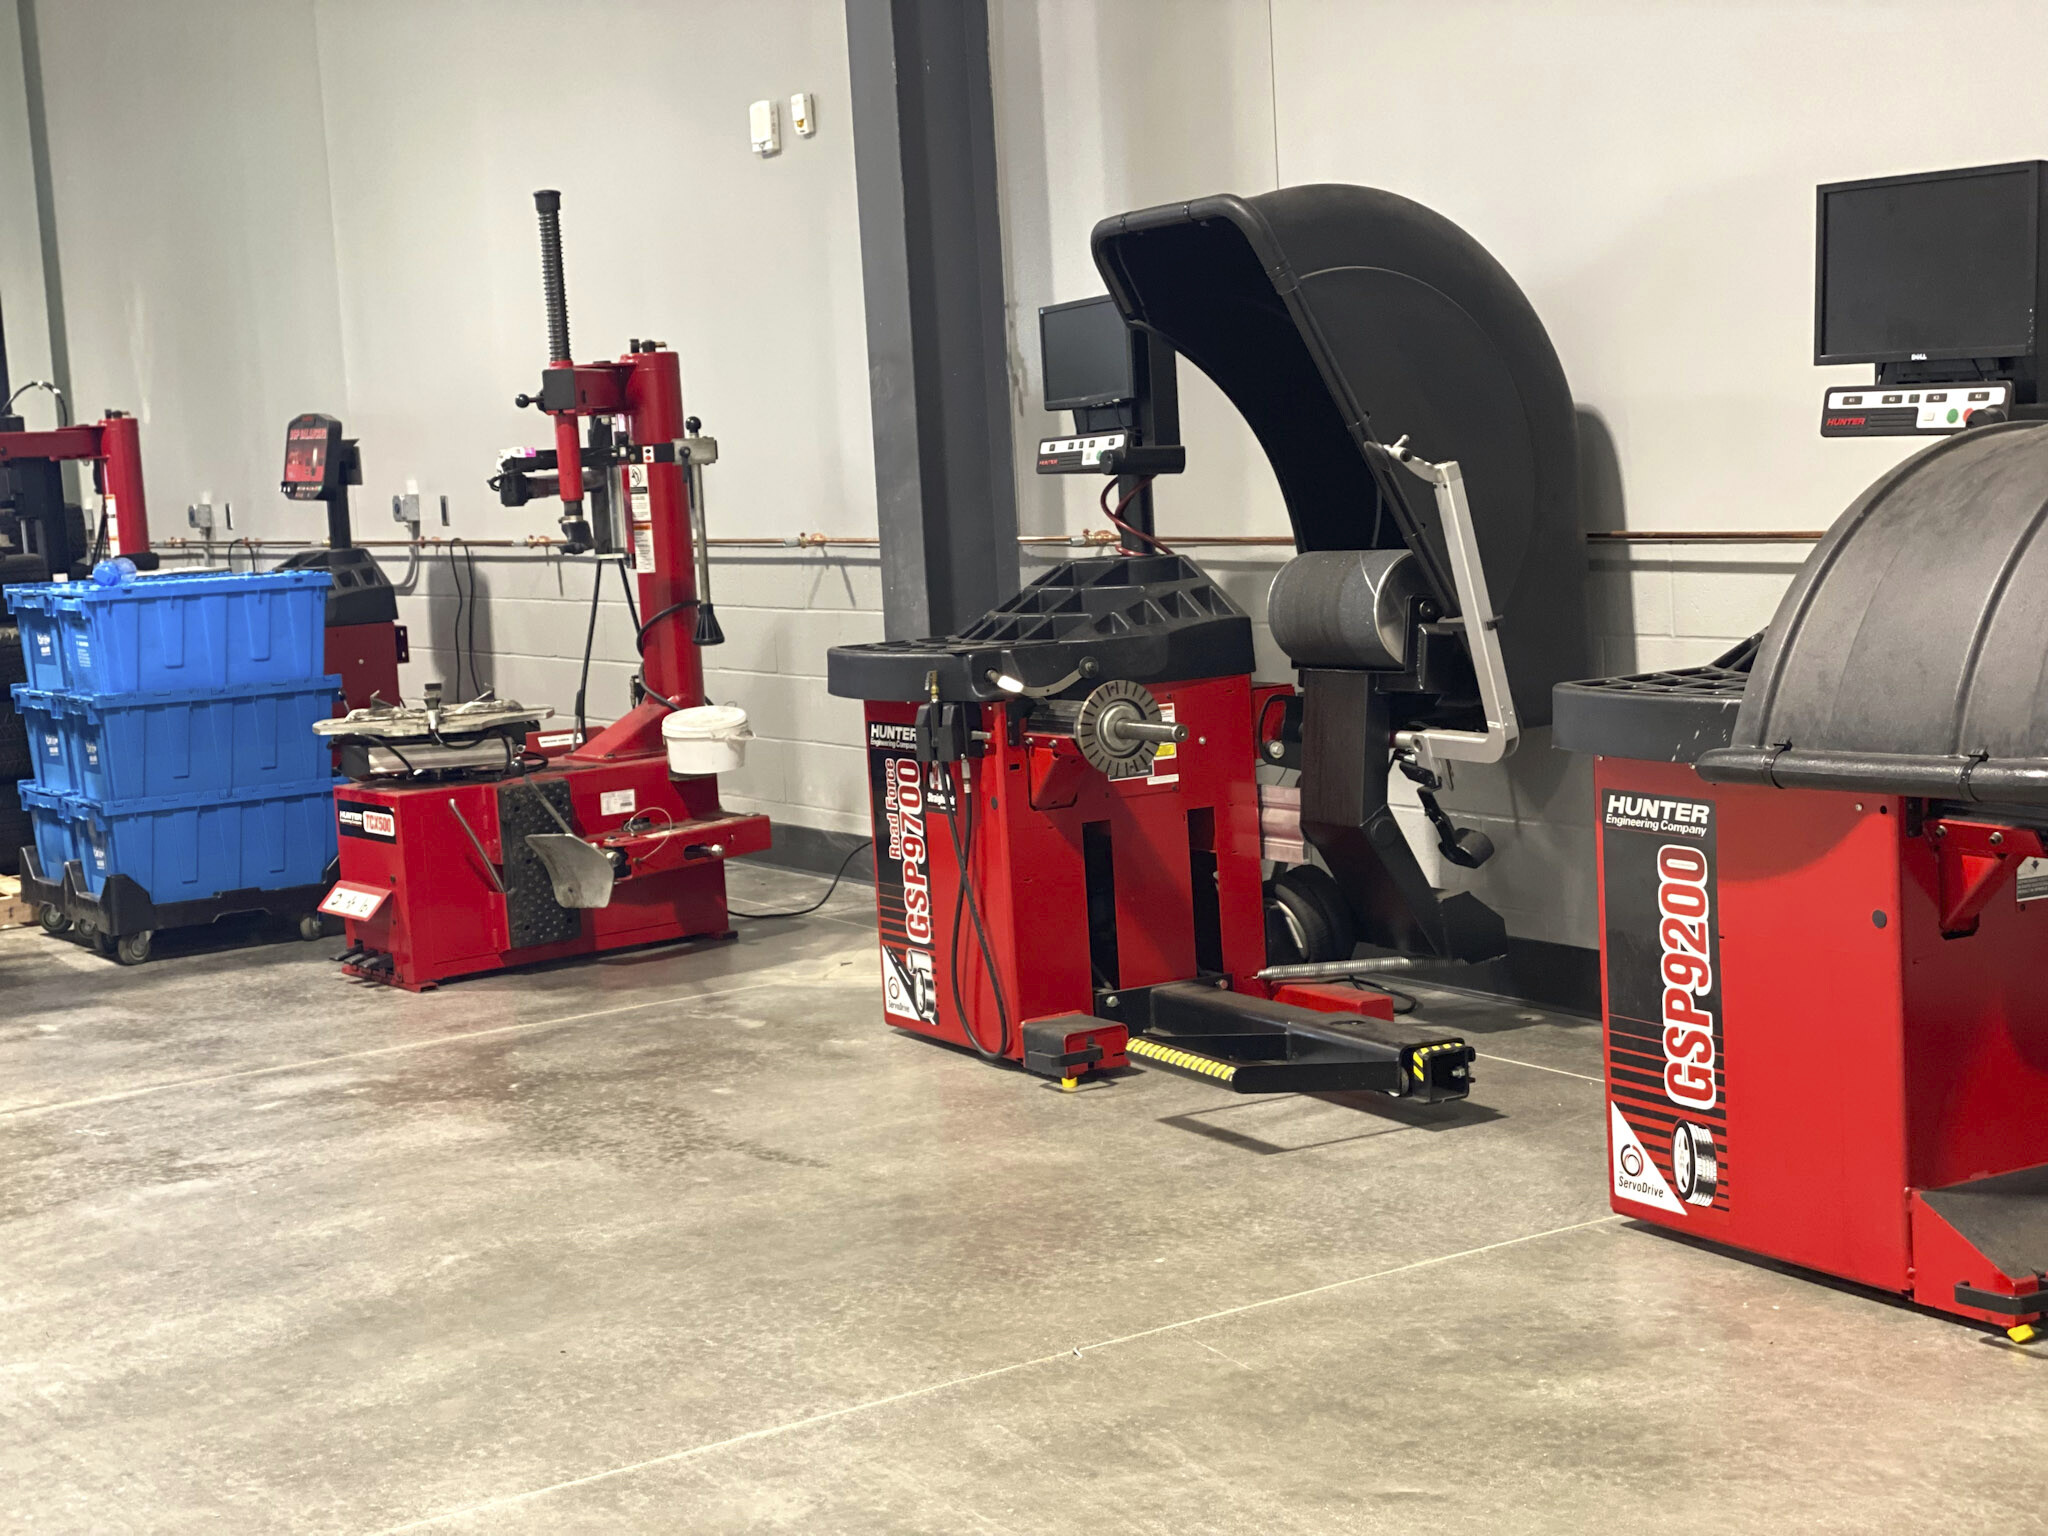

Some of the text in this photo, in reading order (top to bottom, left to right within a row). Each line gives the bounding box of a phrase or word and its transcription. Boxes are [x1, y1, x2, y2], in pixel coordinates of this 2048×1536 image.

[1827, 417, 1866, 426] HUNTER
[871, 724, 916, 741] HUNTER
[871, 738, 895, 748] Engineering
[885, 758, 901, 860] Road Force
[1607, 795, 1710, 824] HUNTER
[365, 813, 392, 833] TCX500
[1606, 814, 1707, 837] Engineering Company
[896, 758, 931, 945] GSP9700
[1657, 843, 1716, 1110] GSP9200
[1618, 1175, 1664, 1199] ServoDrive
